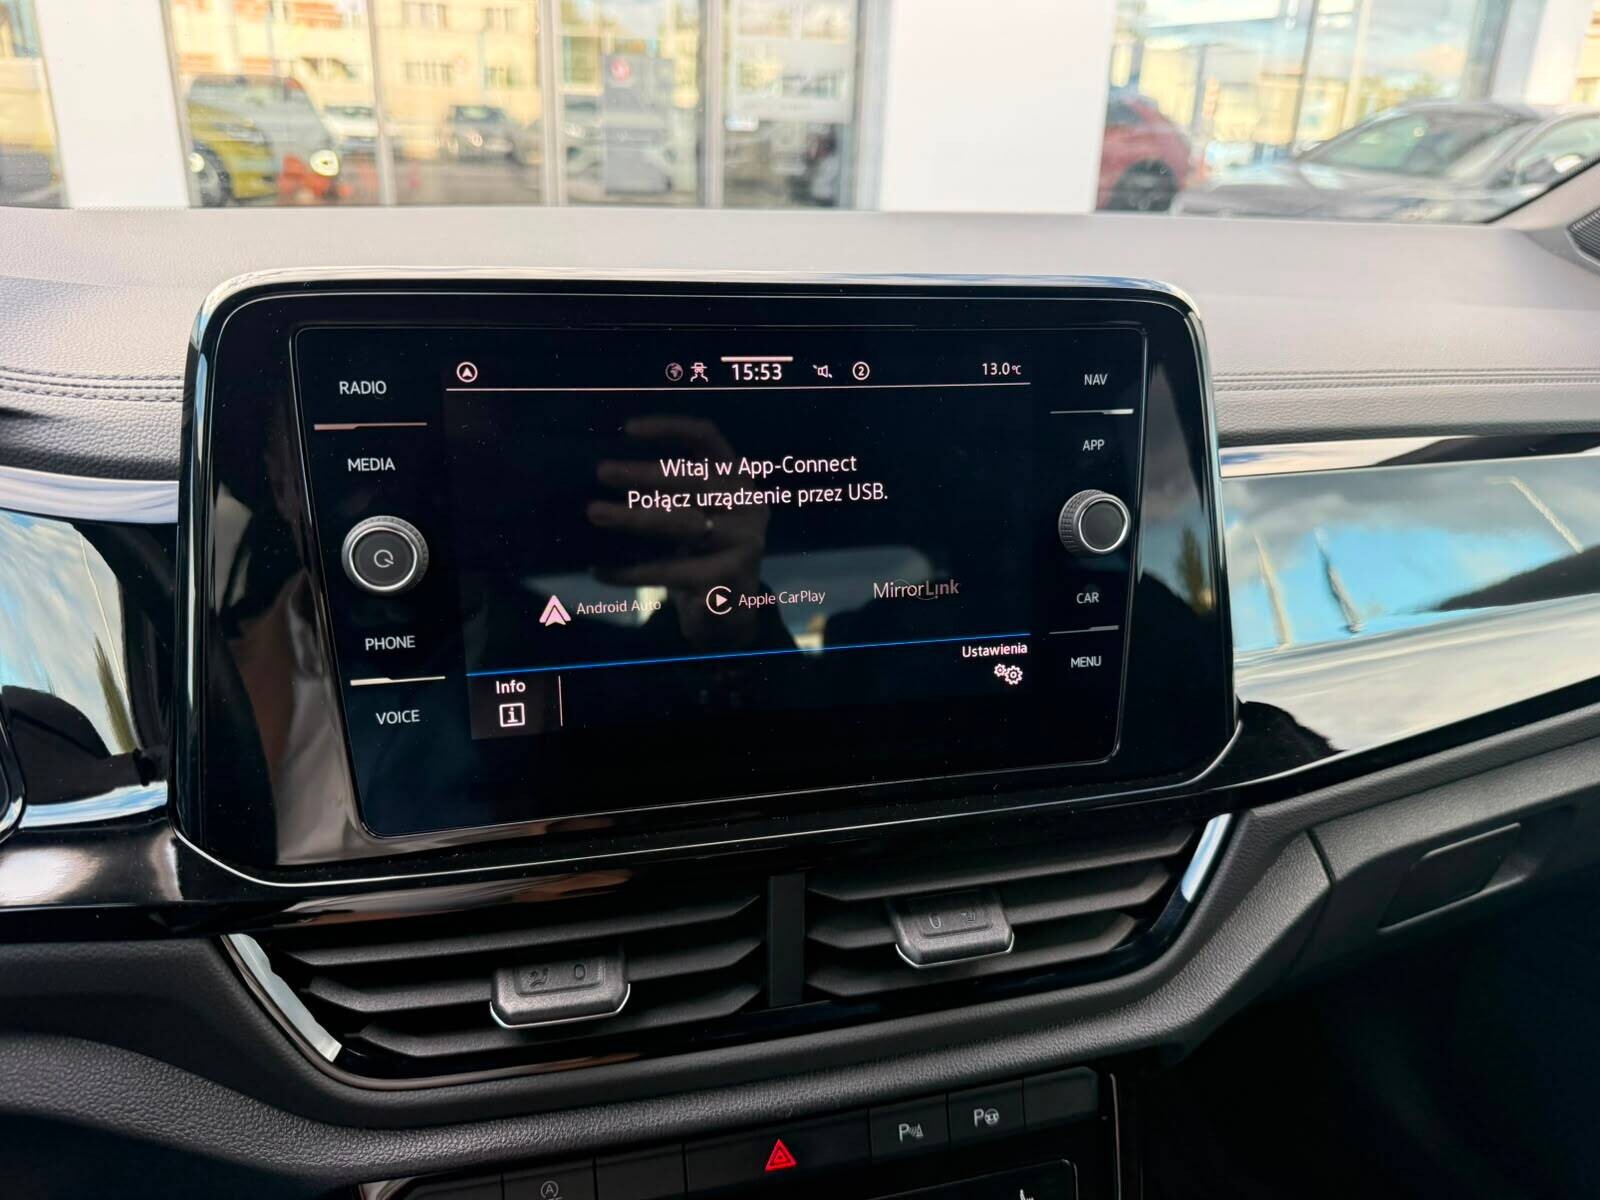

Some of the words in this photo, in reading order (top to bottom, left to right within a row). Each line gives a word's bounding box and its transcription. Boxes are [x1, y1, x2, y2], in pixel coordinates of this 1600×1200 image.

[731, 363, 783, 381] 15:53
[1084, 373, 1108, 386] NAV
[338, 380, 387, 395] RADIO
[1082, 438, 1105, 451] APP
[347, 457, 396, 472] MEDIA
[660, 457, 710, 481] Witaj
[715, 462, 733, 476] w
[738, 454, 858, 479] App-Connect
[628, 489, 691, 513] Połącz
[697, 486, 792, 511] urządzenie
[797, 488, 843, 508] przez
[848, 483, 889, 502] USB.
[872, 580, 960, 600] MirrorLink
[738, 593, 776, 609] Apple
[778, 588, 826, 606] CarPlay
[1076, 592, 1100, 605] CAR
[576, 600, 628, 616] Android
[630, 599, 662, 613] Auto
[365, 635, 416, 651] PHONE
[961, 643, 1028, 659] Ustawienia
[1070, 655, 1102, 668] MENU
[495, 679, 527, 695] Info
[375, 709, 420, 725] VOICE
